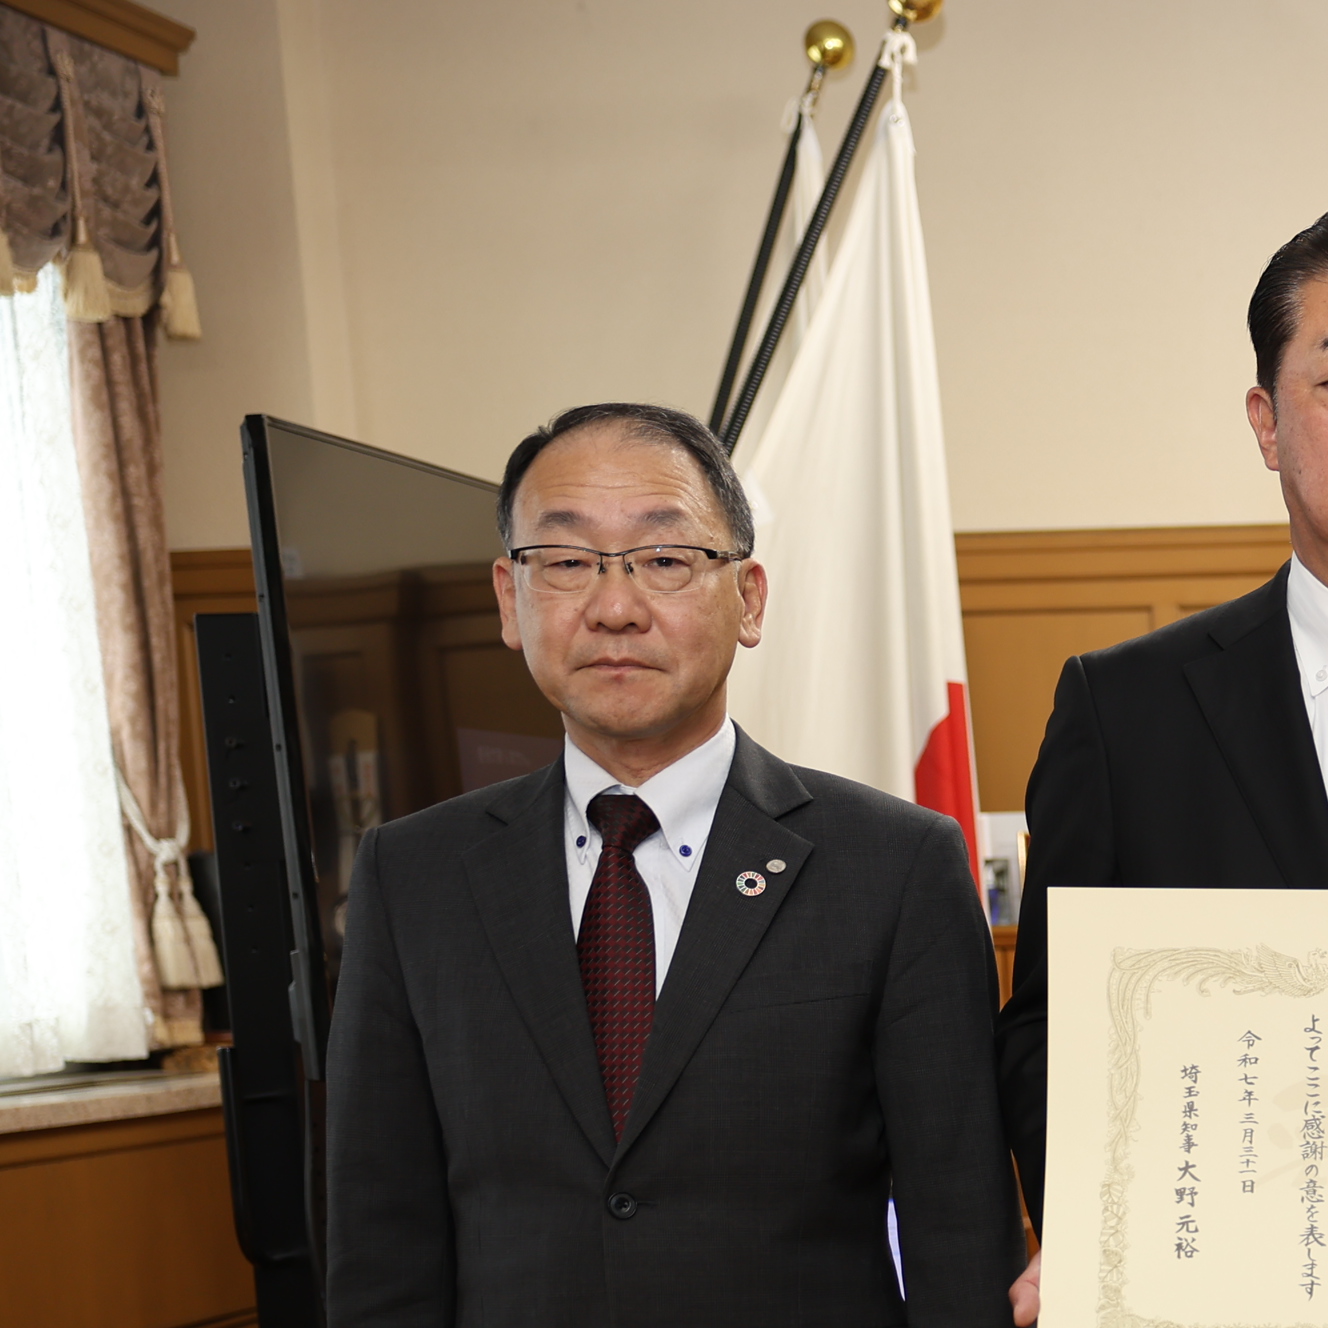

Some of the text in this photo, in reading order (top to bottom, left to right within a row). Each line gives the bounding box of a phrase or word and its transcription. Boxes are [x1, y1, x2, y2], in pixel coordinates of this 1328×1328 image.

[1237, 1030, 1262, 1194] 令和七年三月三十一日
[1299, 1014, 1328, 1300] よってここに感謝の意を表します
